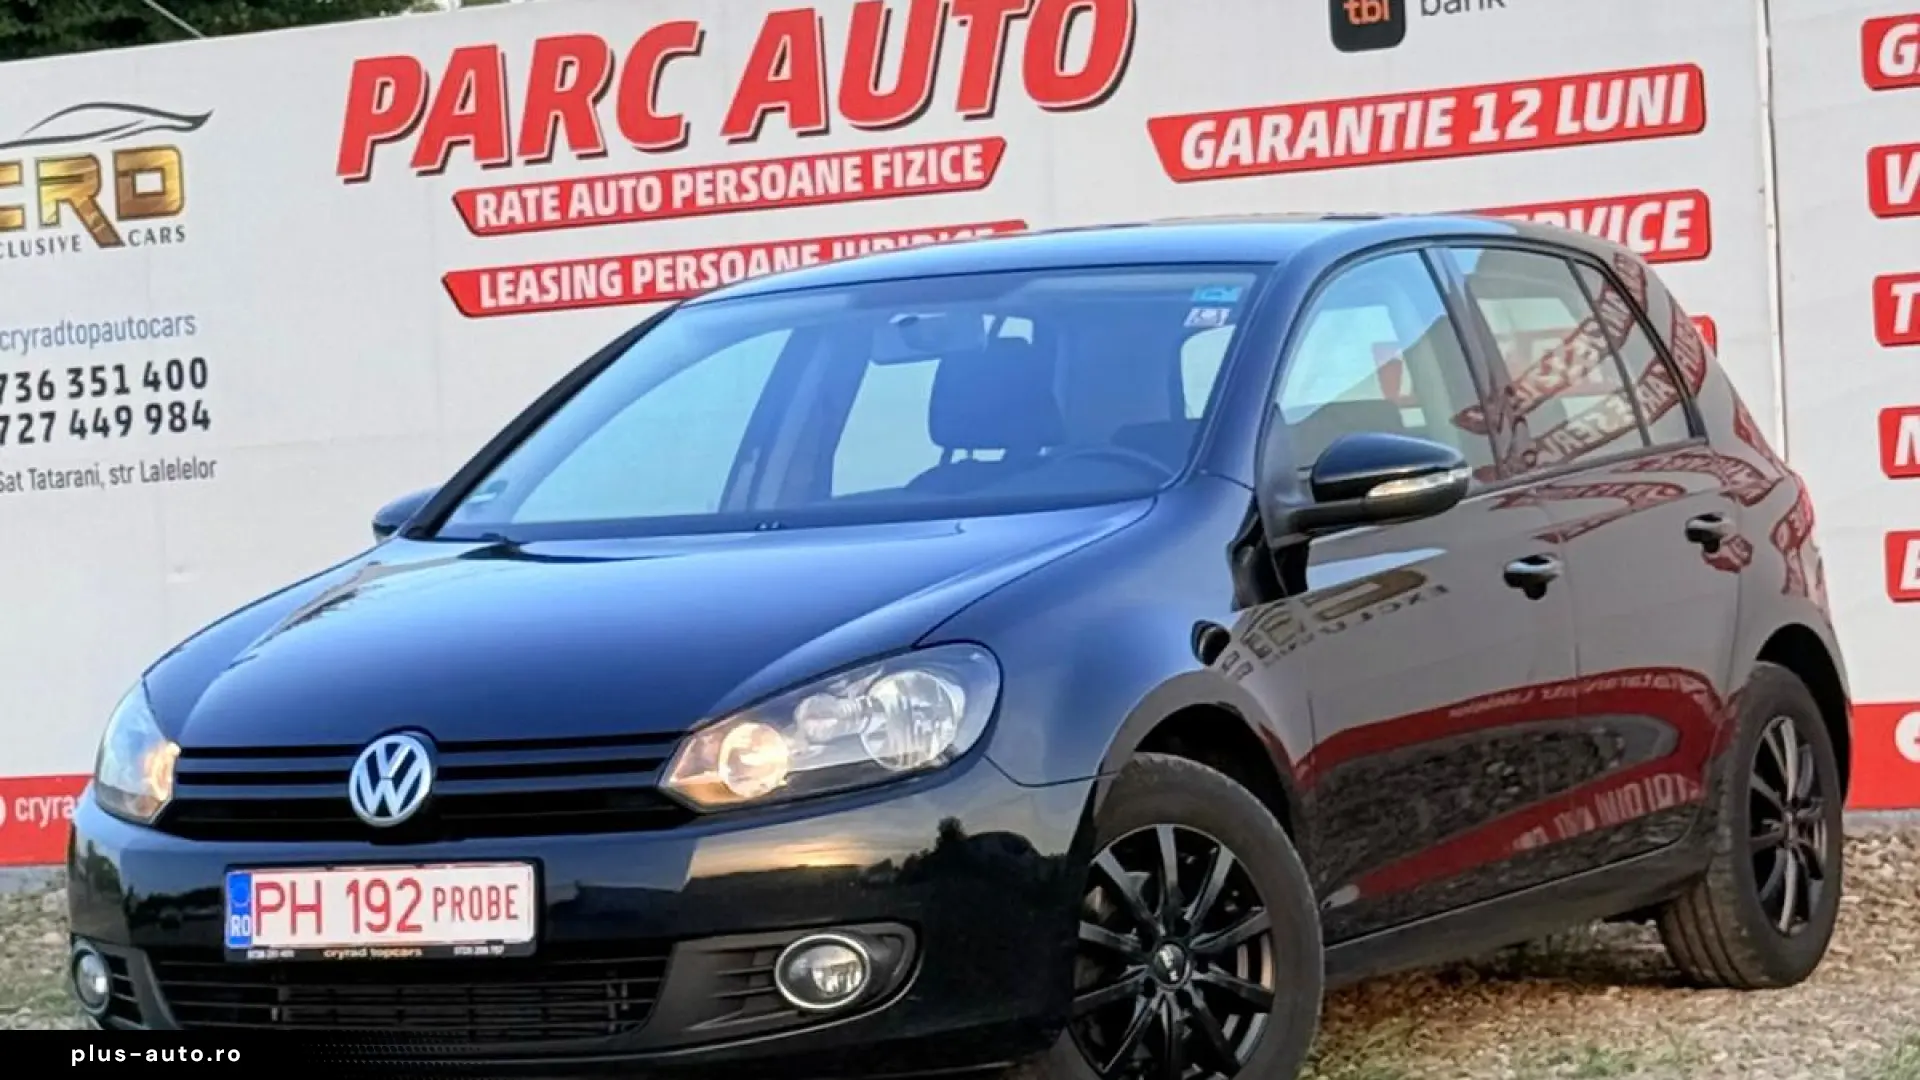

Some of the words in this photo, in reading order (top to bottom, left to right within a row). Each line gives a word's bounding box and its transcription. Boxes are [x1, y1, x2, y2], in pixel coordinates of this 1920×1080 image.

[1421, 0, 1506, 16] ban
[1879, 23, 1920, 77] G
[336, 20, 704, 184] PARC
[720, 0, 1136, 145] AUTO
[1180, 97, 1456, 170] GARANTIE
[1468, 88, 1542, 145] 12
[1555, 72, 1689, 136] LUNI
[475, 186, 561, 228] RATE
[568, 176, 661, 218] AUTO
[672, 156, 862, 209] PERSOANE
[872, 144, 985, 190] FIZICE
[128, 224, 186, 248] CARS
[1503, 199, 1695, 254] VICE
[480, 262, 623, 308] LEASING
[632, 243, 820, 295] PERSOANE
[0, 315, 196, 355] cryradtopautocars
[67, 363, 130, 399] 351
[142, 356, 208, 392] 400
[69, 405, 133, 440] 449
[145, 399, 211, 435] 984
[27, 463, 105, 490] Tatarani,
[109, 463, 135, 485] str
[140, 456, 217, 483] Lalelelor
[230, 915, 250, 937] RO
[255, 880, 321, 936] PH
[346, 877, 423, 934] 192
[432, 884, 519, 922] PROBE
